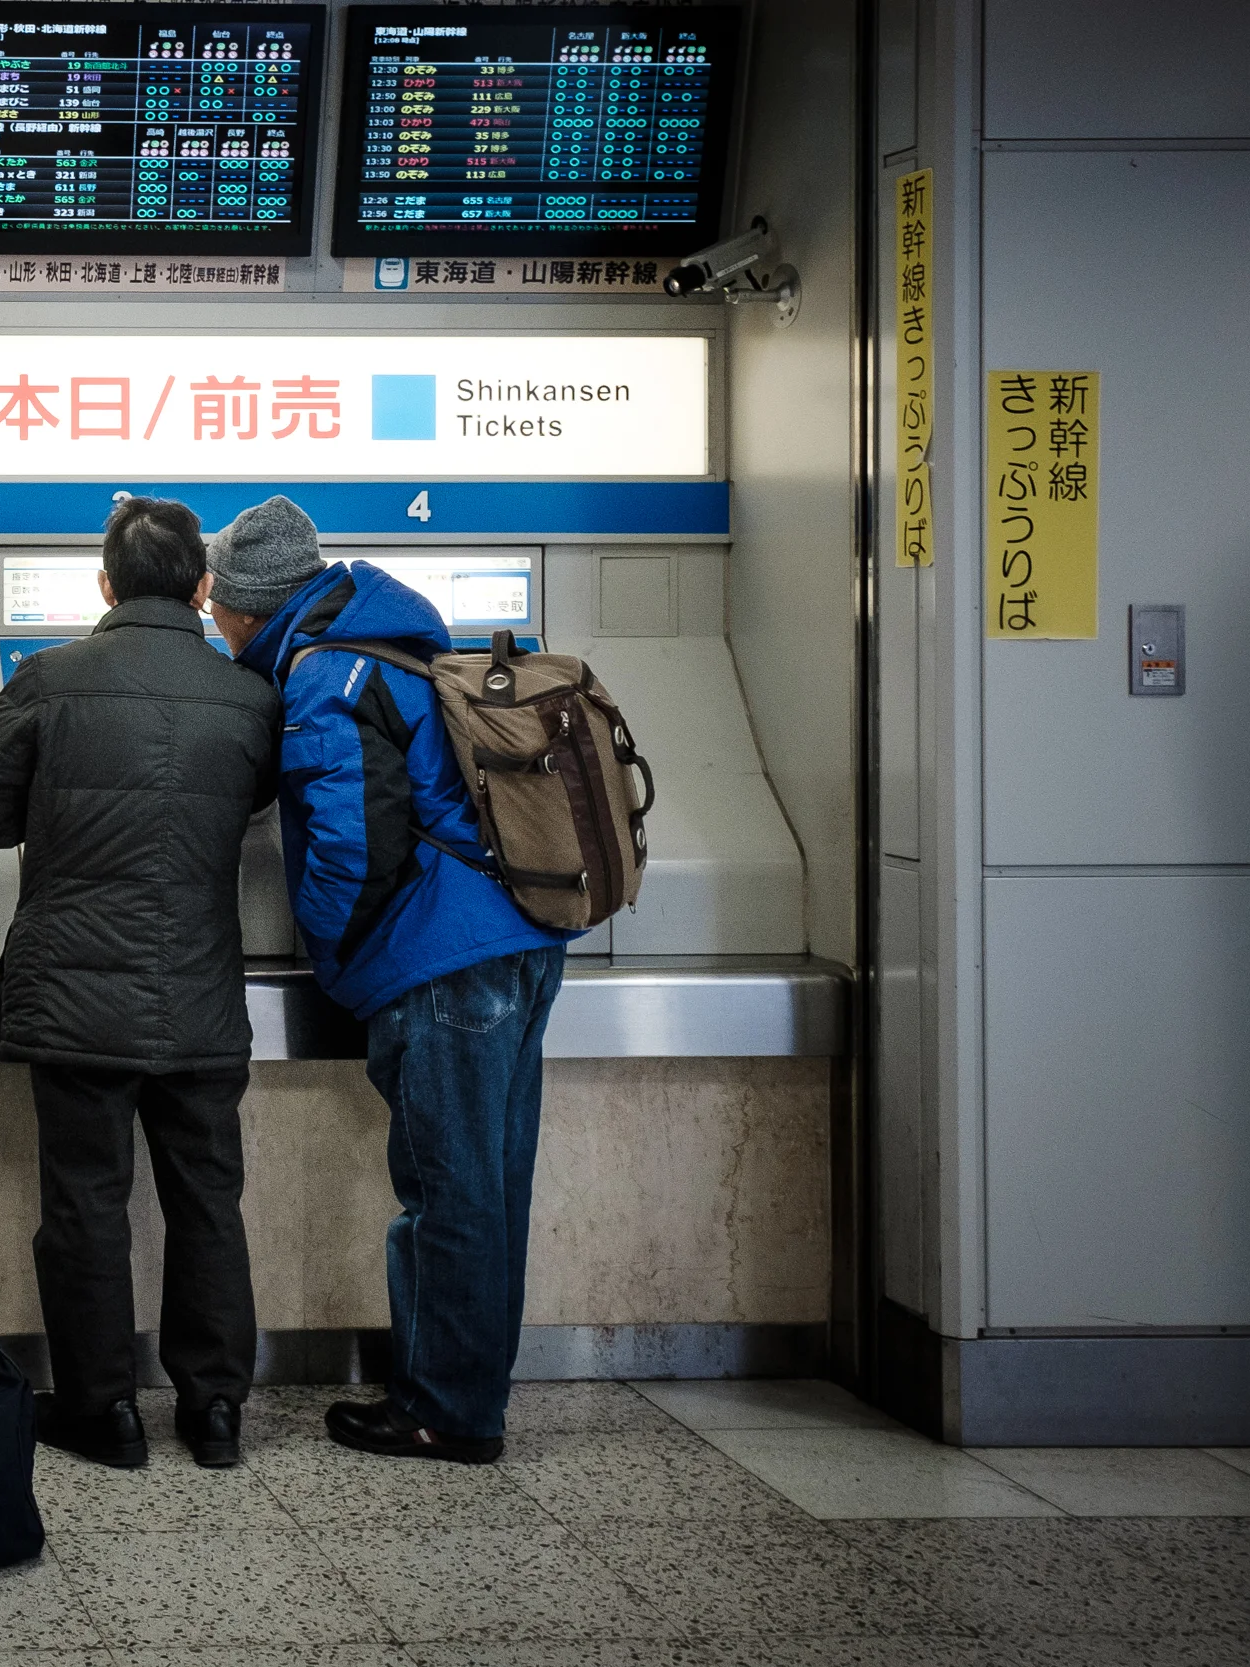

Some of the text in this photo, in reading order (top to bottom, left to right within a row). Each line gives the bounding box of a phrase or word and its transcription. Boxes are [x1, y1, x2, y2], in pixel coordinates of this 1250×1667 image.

[373, 66, 398, 74] 12:30
[403, 66, 437, 75] のぞみ
[67, 73, 80, 81] 19
[372, 79, 397, 87] 12:33
[403, 79, 436, 87] ひかり
[473, 79, 493, 87] 513
[66, 85, 79, 93] 51
[402, 92, 435, 101] のぞみ
[472, 92, 492, 100] 111
[59, 99, 79, 107] 139
[401, 105, 434, 114] のぞみ
[470, 106, 491, 114] 229
[58, 111, 79, 119] 139
[400, 118, 432, 127] ひかり
[469, 119, 490, 127] 473
[399, 131, 432, 140] のぞみ
[475, 132, 489, 140] 35
[398, 144, 431, 153] のぞみ
[473, 145, 488, 153] 37
[56, 159, 76, 167] 563
[397, 157, 429, 166] ひかり
[467, 158, 487, 166] 515
[55, 171, 75, 179] 321
[396, 170, 429, 179] のぞみ
[465, 171, 486, 179] 113
[54, 184, 75, 192] 611
[54, 196, 75, 204] 565
[394, 196, 426, 205] こだま
[462, 197, 483, 205] 655
[393, 209, 425, 218] こだま
[461, 210, 482, 218] 657
[415, 260, 657, 285] 東海道・山陽新幹線
[902, 175, 927, 557] 新幹線きっぷうりば
[456, 378, 631, 402] Shinkansen
[456, 414, 563, 438] Tickets
[1049, 374, 1088, 502] 新幹線
[407, 490, 432, 522] 4
[999, 374, 1038, 632] きっぷうりば
